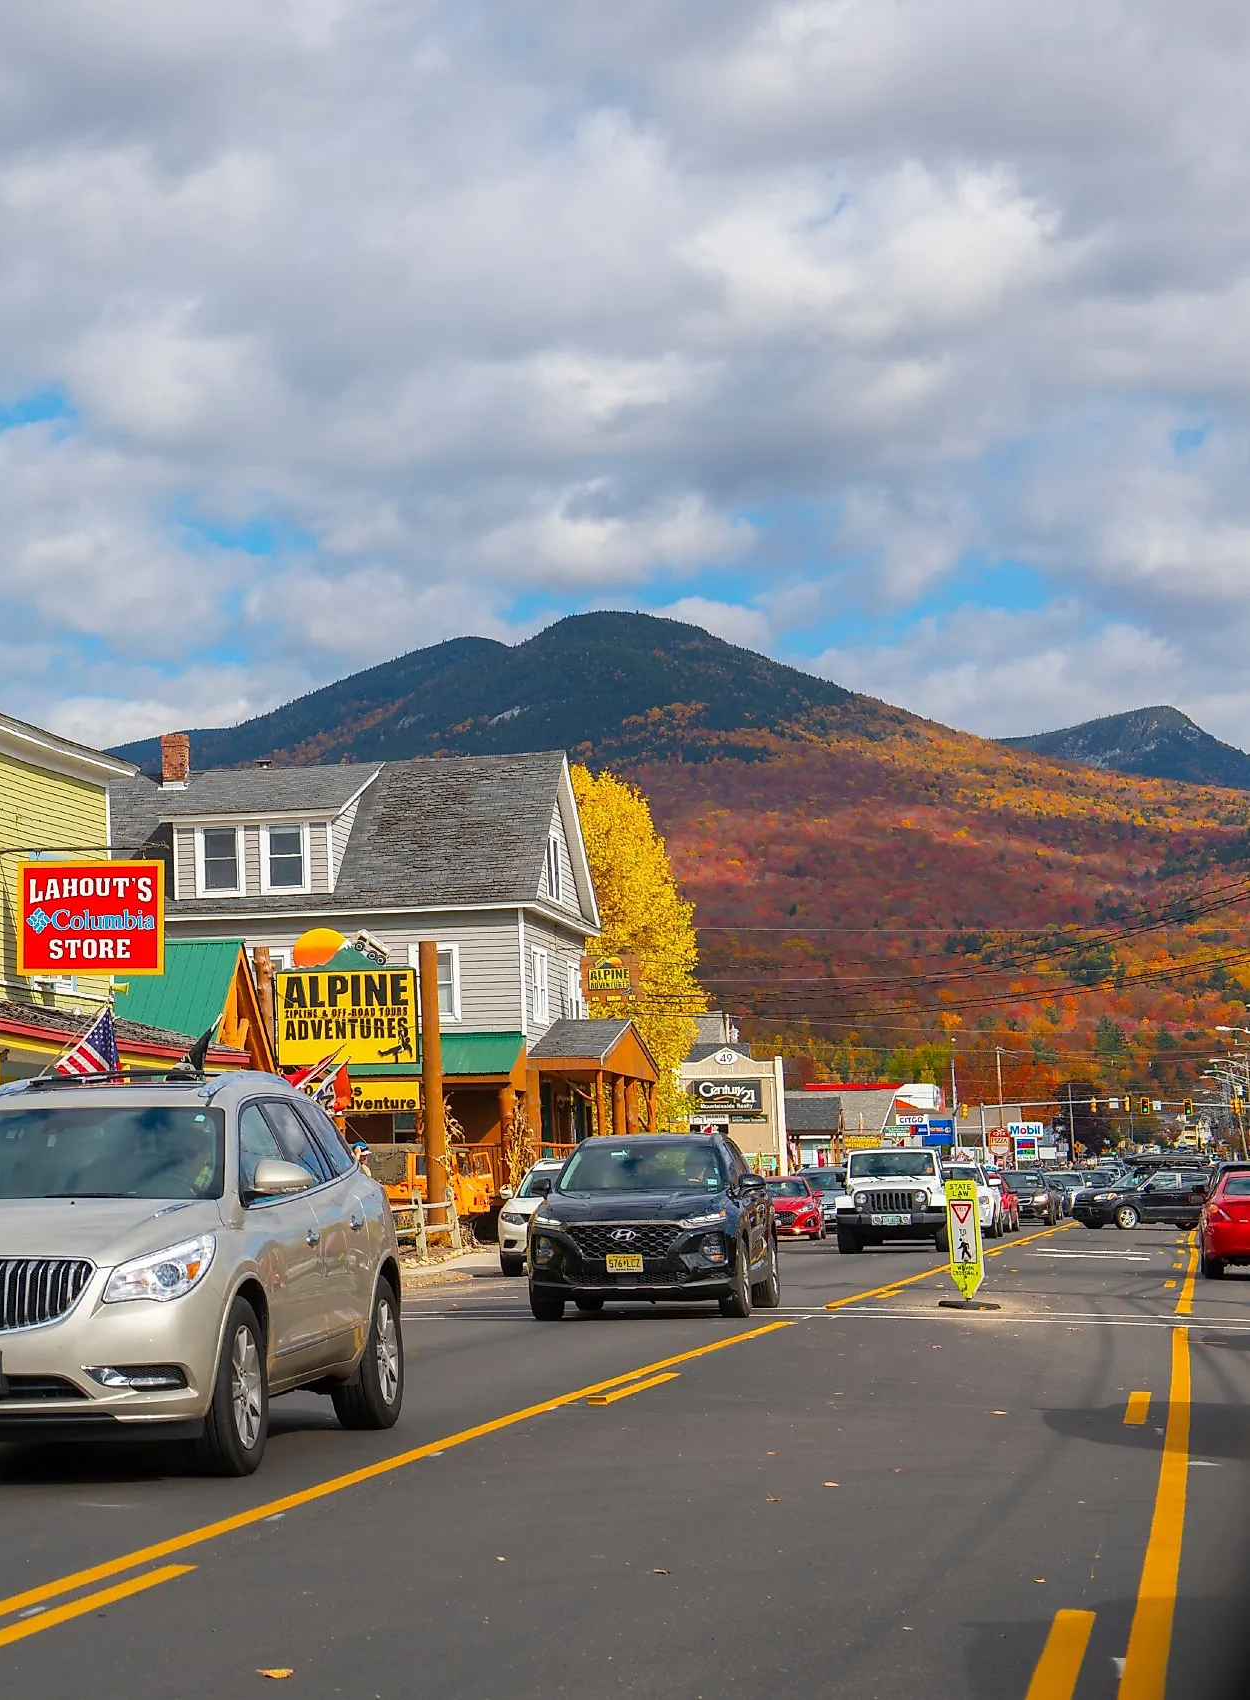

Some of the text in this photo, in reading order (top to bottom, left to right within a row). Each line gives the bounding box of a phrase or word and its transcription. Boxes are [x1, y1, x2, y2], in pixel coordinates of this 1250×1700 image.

[29, 877, 152, 904] LAHOUT'S
[50, 909, 155, 931] Columbia
[49, 938, 131, 960] STORE
[590, 969, 629, 980] ALPINE
[284, 973, 408, 1009] ALPINE
[285, 1008, 318, 1019] ZIPLINE
[332, 1008, 376, 1017] OFF-ROAD
[380, 1006, 408, 1016] TOURS
[285, 1017, 408, 1040] ADVENTURES
[720, 1054, 732, 1063] 49
[699, 1082, 756, 1103] Century 21
[1010, 1126, 1040, 1134] Mobil
